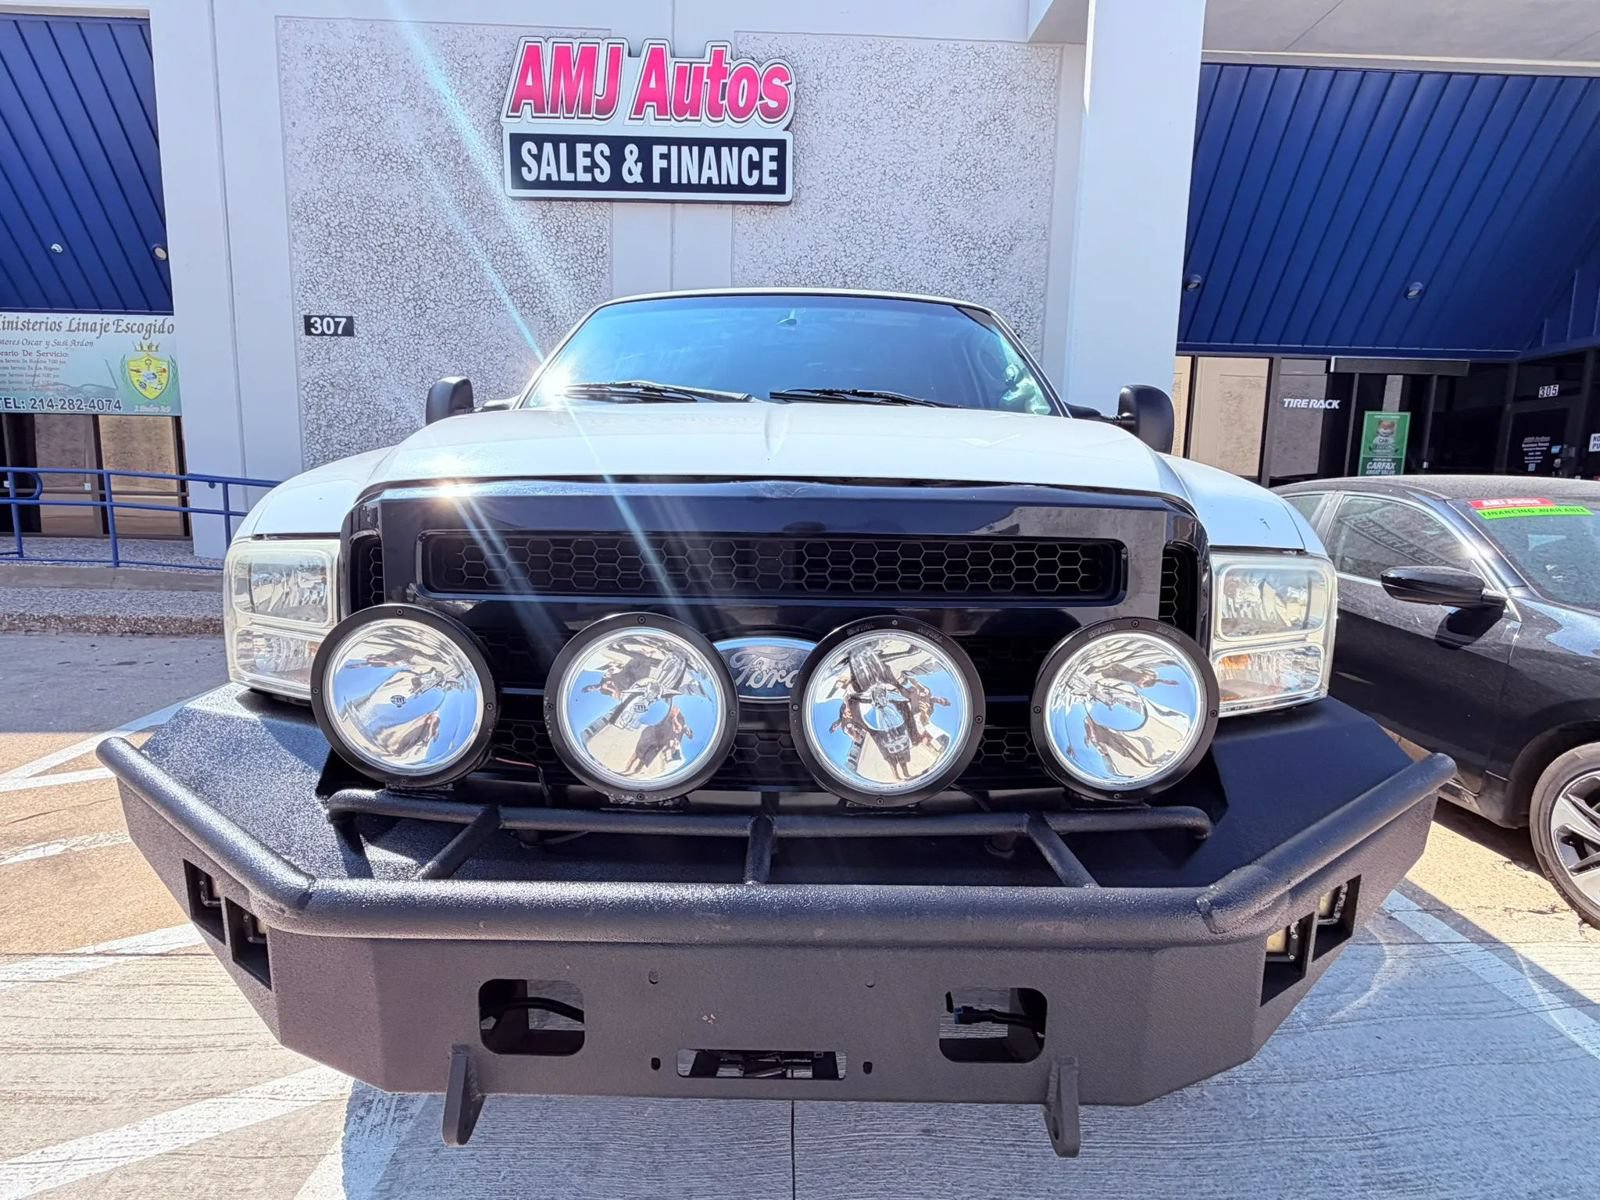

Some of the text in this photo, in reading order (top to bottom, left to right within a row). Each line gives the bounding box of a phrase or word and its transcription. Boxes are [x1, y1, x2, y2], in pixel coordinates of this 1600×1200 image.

[508, 41, 792, 122] AMJ Autos
[520, 140, 779, 187] SALES & FINANCE
[0, 314, 175, 340] inisterios Linaje Escogido
[310, 316, 347, 335] 307
[22, 349, 33, 357] De
[1539, 385, 1559, 397] 305
[29, 398, 122, 411] 214-282-4074
[1283, 398, 1341, 409] TIRE RACK
[1366, 461, 1396, 470] CARFAX
[1482, 507, 1536, 517] FINANCING
